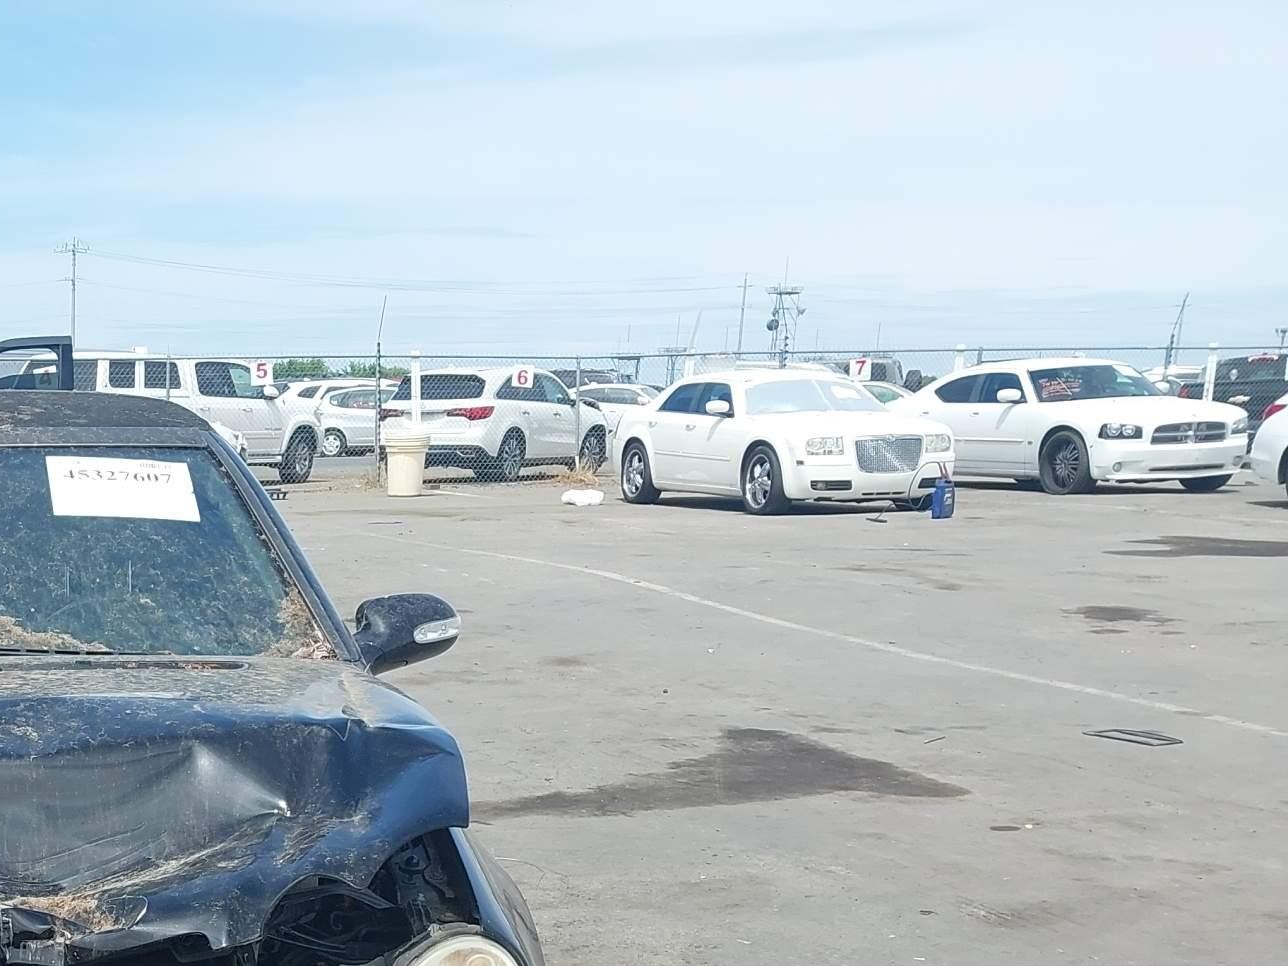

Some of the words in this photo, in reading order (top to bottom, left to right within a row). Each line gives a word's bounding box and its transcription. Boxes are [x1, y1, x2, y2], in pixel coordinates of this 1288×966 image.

[255, 362, 268, 379] 5
[855, 359, 867, 376] 7
[517, 369, 529, 386] 6
[63, 468, 172, 484] 45327607
